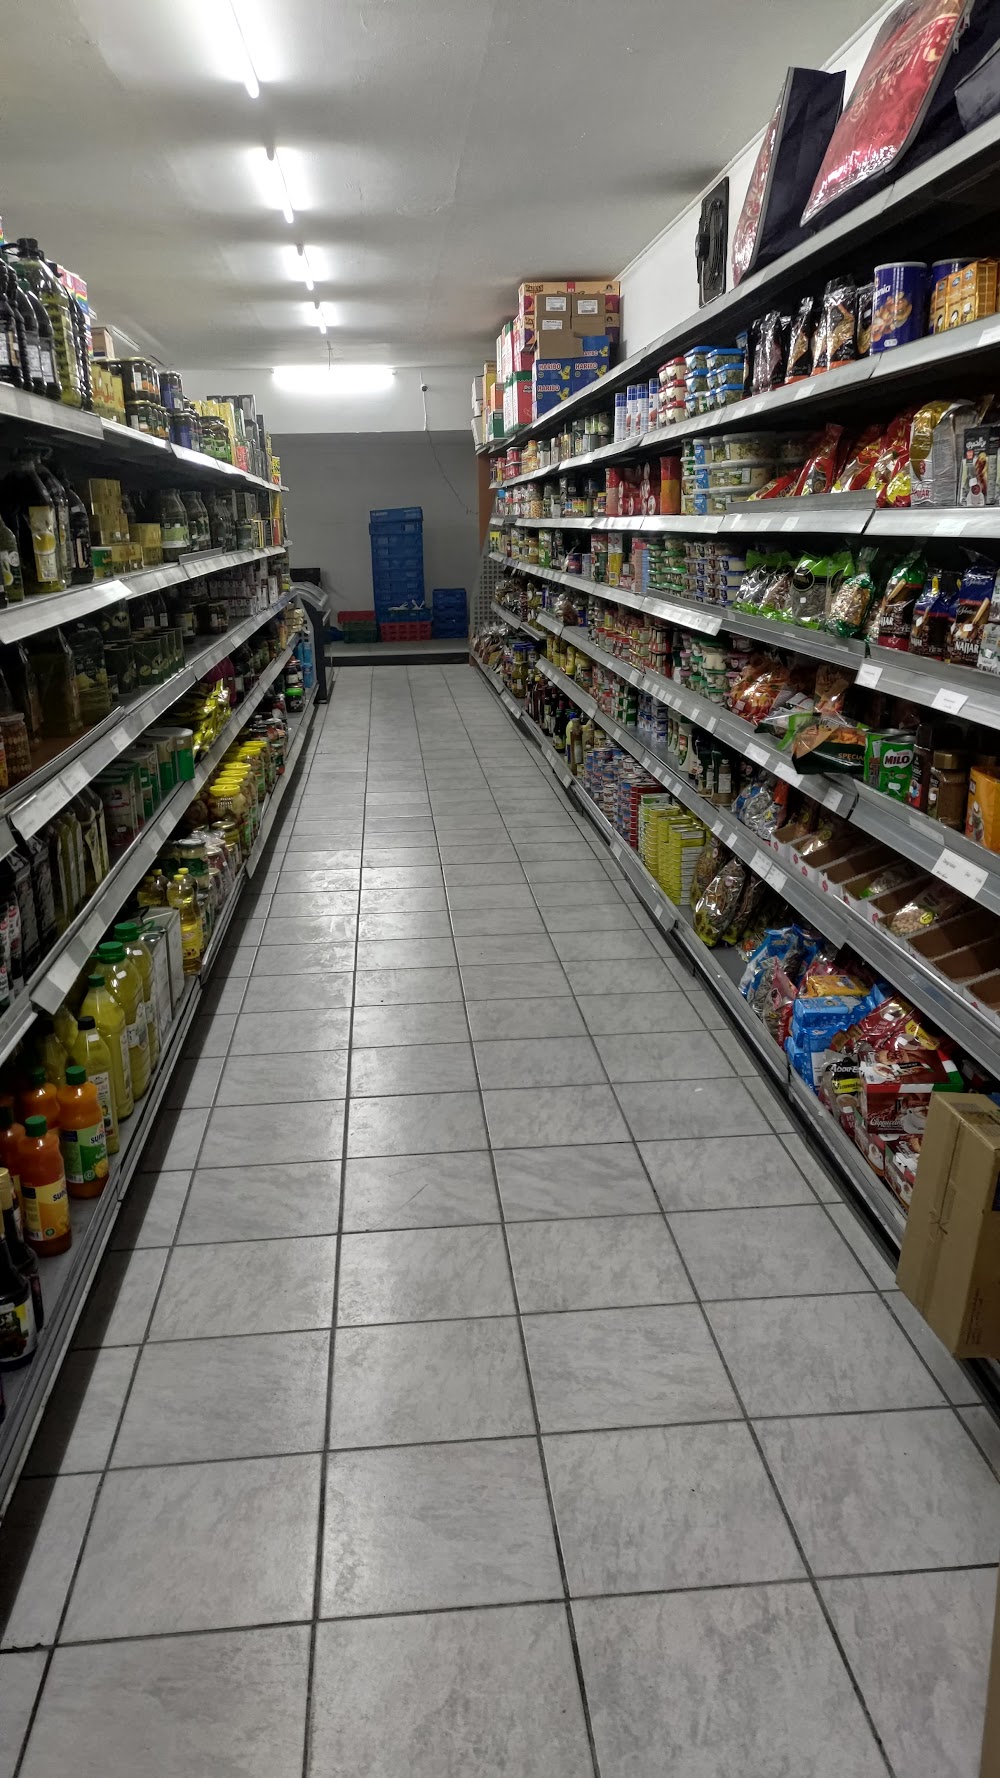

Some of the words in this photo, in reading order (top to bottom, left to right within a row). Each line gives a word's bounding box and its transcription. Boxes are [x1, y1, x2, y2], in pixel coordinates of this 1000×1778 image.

[538, 363, 562, 371] HARIBO
[574, 362, 598, 370] HARIBO
[537, 384, 560, 392] HARIBO
[954, 640, 980, 654] NAJJAR
[837, 752, 864, 760] SPECIA
[884, 755, 910, 765] MILO
[870, 1117, 902, 1128] Cappuccin
